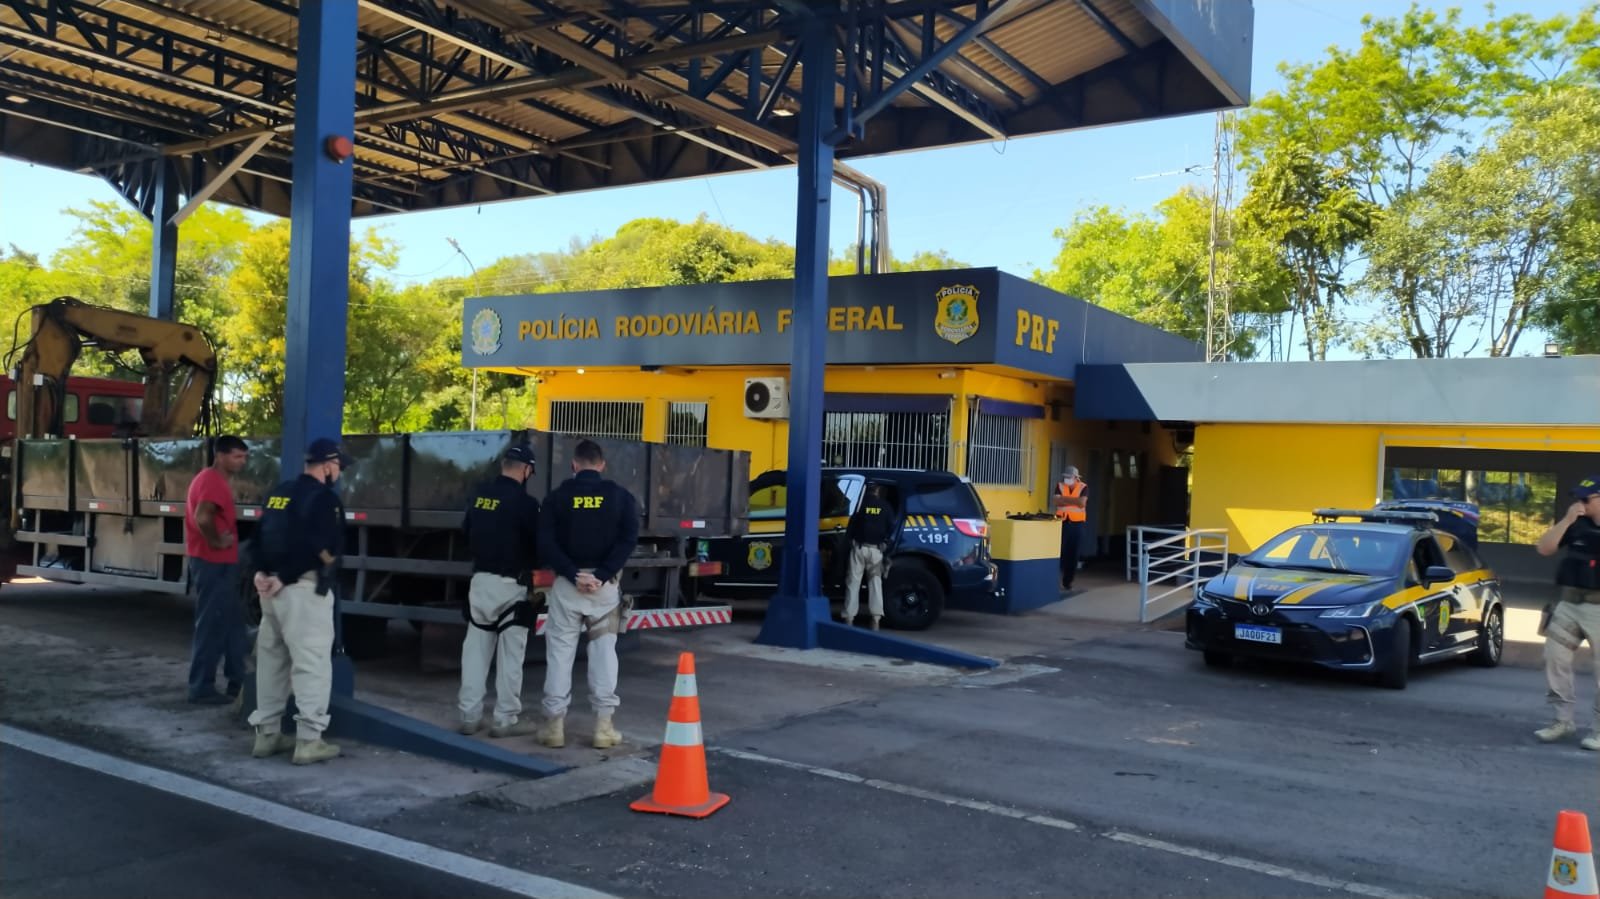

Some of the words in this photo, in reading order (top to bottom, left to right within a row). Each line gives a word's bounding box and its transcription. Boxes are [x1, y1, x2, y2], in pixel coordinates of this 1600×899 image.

[518, 312, 600, 341] POLÍCIA
[615, 306, 760, 337] RODOVIÁRIA
[777, 305, 904, 333] FERAL
[1015, 309, 1059, 354] PRF
[266, 496, 291, 510] PRF
[474, 497, 500, 511] PRF
[573, 496, 604, 509] PRF
[865, 507, 881, 515] PRF
[927, 533, 949, 544] 191
